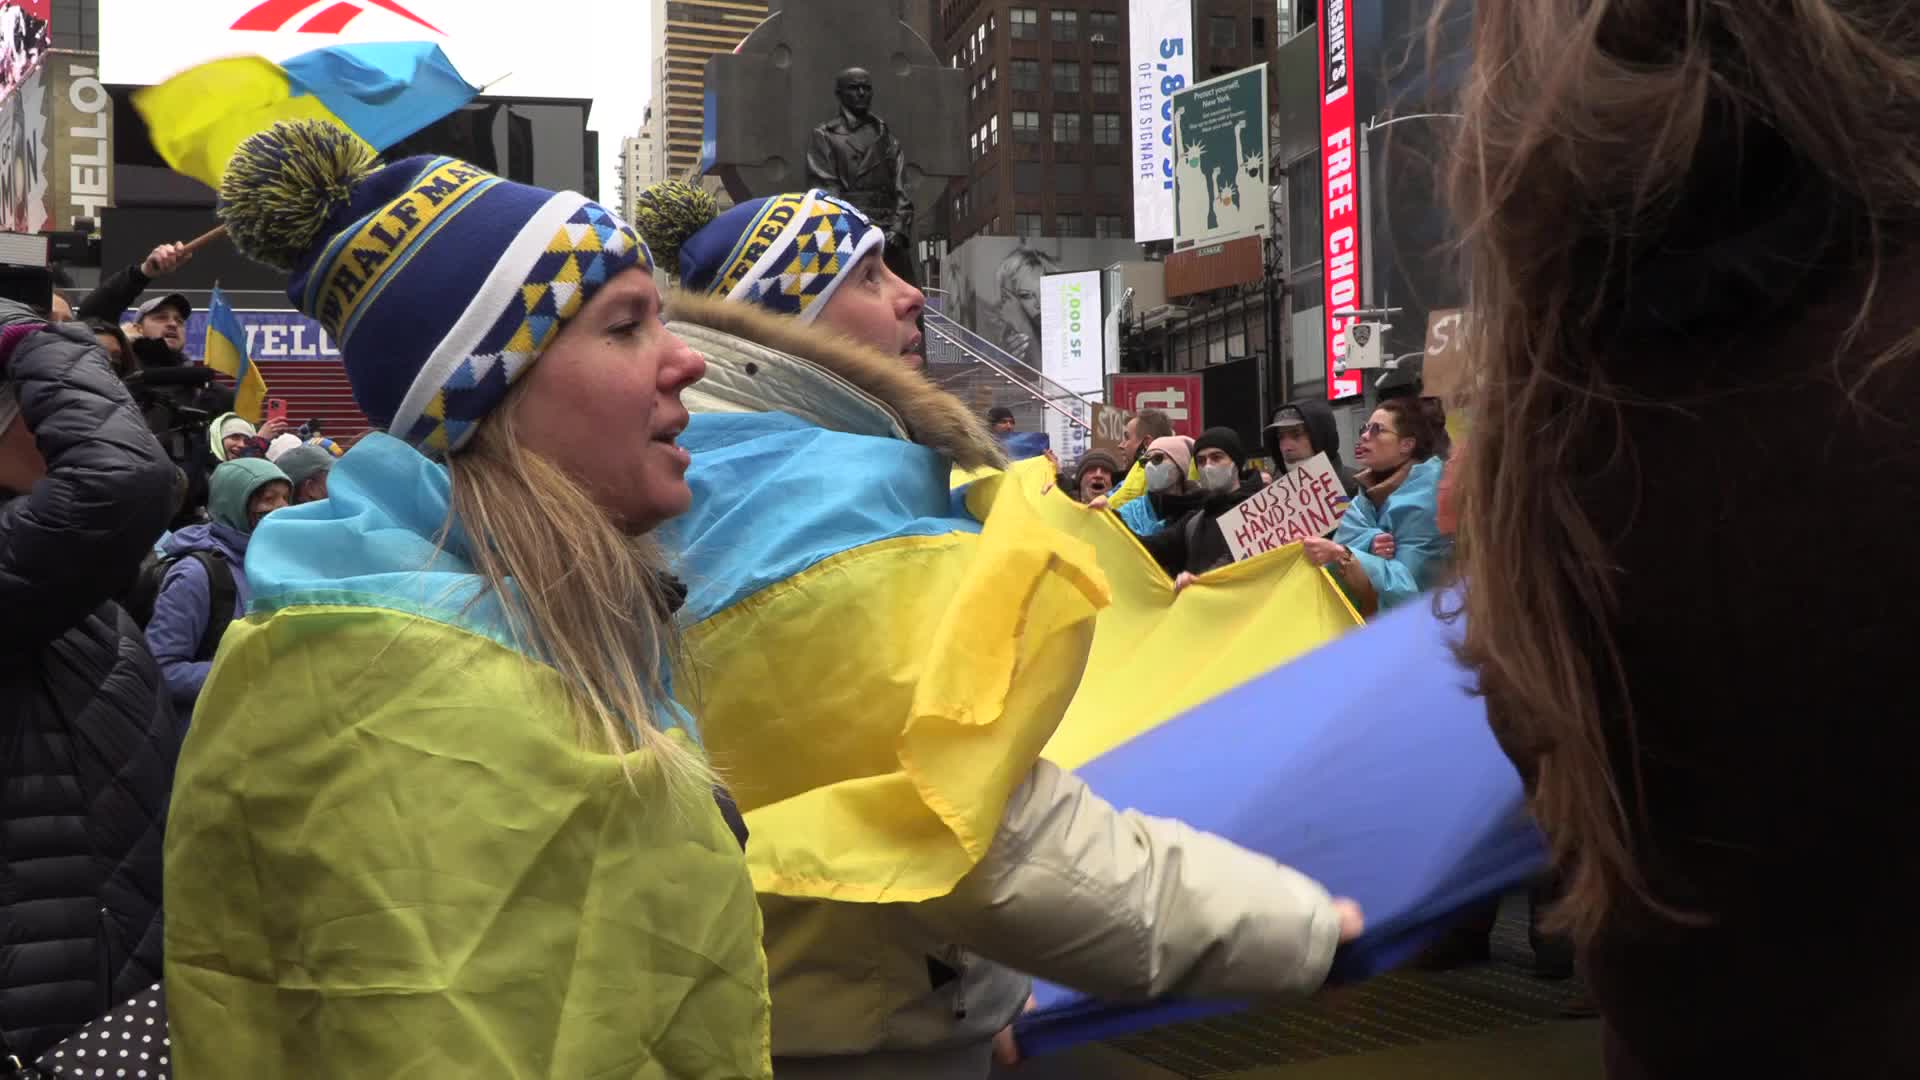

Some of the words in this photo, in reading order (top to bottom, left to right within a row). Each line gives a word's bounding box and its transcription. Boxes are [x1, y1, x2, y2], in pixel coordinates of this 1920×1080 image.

[1138, 62, 1151, 80] OF
[1329, 0, 1346, 82] RSHEY'S
[1139, 86, 1153, 111] LED
[1202, 99, 1217, 108] New
[69, 63, 108, 232] HELLO!
[1140, 116, 1154, 181] SIGNAGE
[1327, 126, 1352, 219] FREE
[332, 197, 421, 304] HALF
[729, 205, 795, 281] FRED
[1070, 338, 1081, 358] SF
[1329, 226, 1358, 399] CHOCOA
[1234, 498, 1296, 548] HANDS
[1299, 471, 1333, 507] OFF
[1239, 466, 1314, 523] RUSSIA
